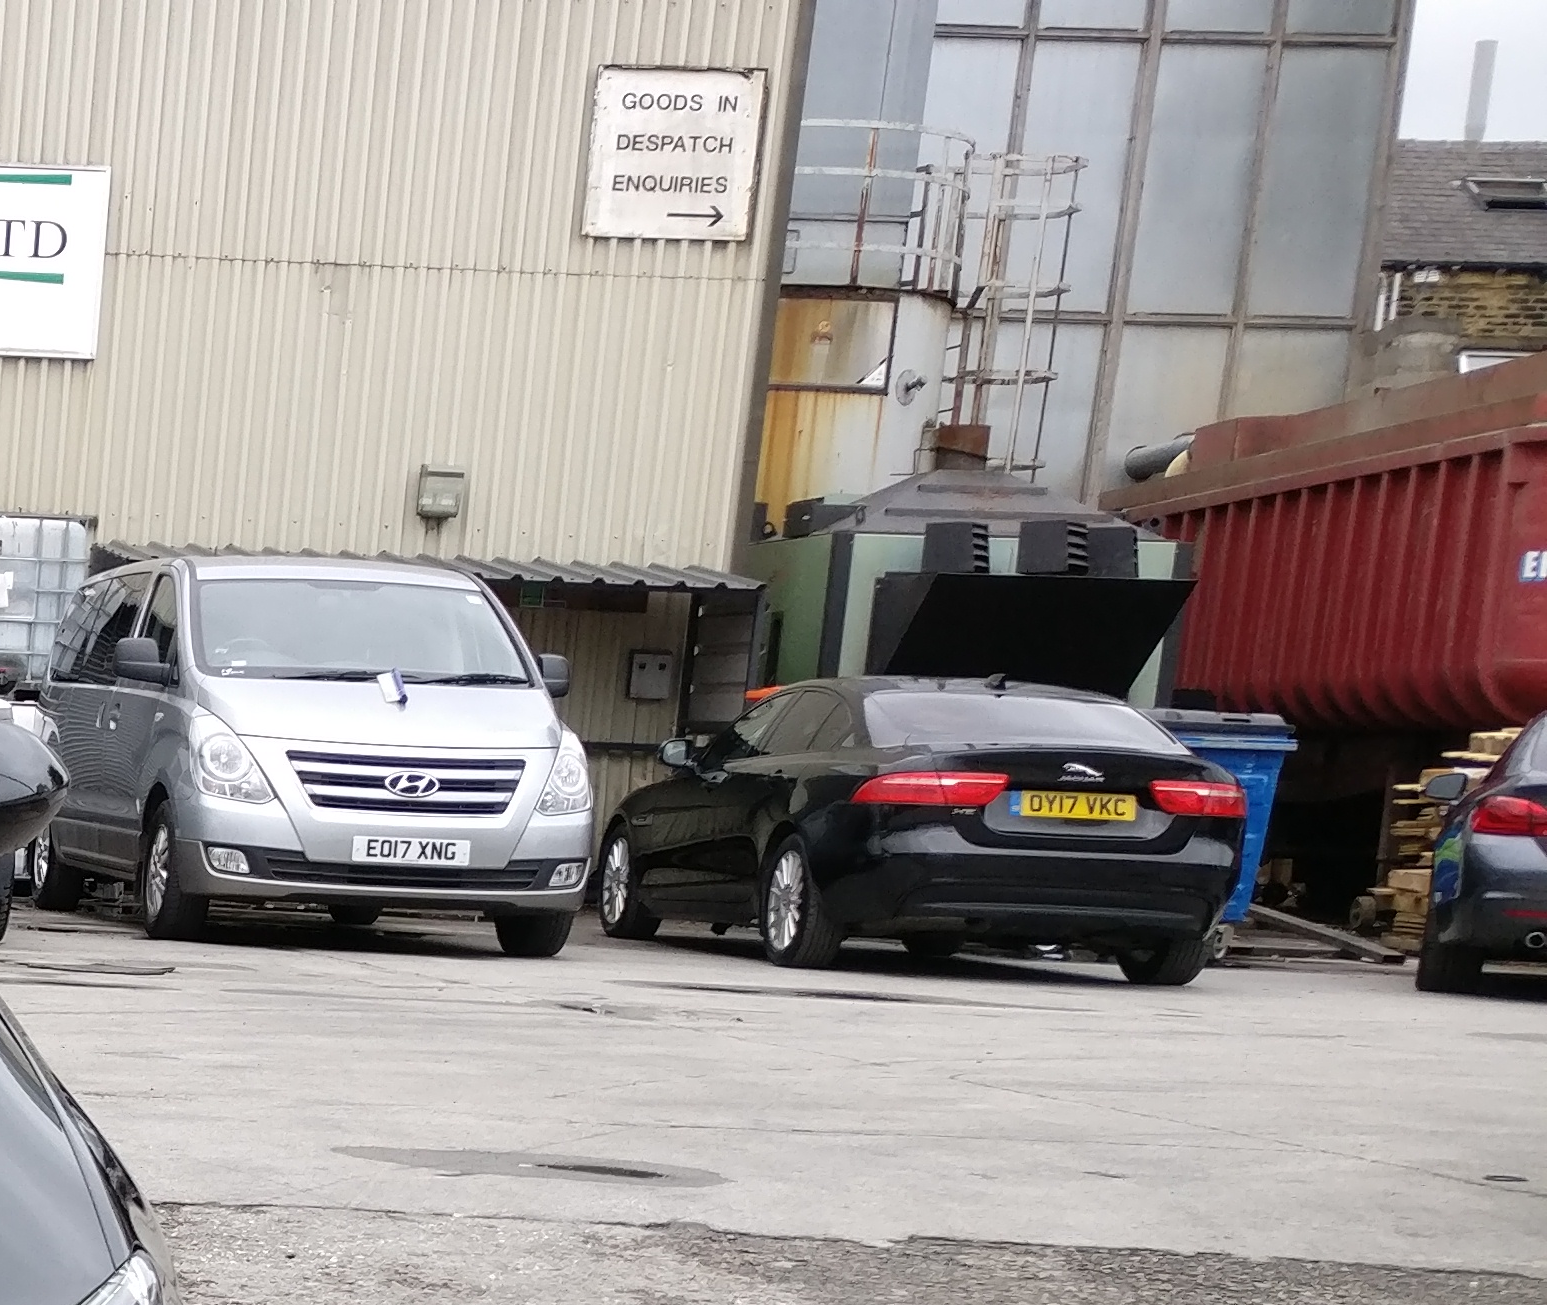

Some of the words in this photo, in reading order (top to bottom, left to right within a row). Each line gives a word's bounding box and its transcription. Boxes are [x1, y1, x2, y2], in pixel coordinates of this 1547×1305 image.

[621, 92, 704, 112] GOODS
[717, 95, 739, 113] IN
[615, 134, 734, 154] DESPATCH
[611, 174, 729, 194] ENQUIRIES
[1029, 794, 1079, 814] OY17
[1085, 796, 1127, 817] VKC
[365, 838, 412, 859] EO17
[416, 840, 457, 861] XNG
